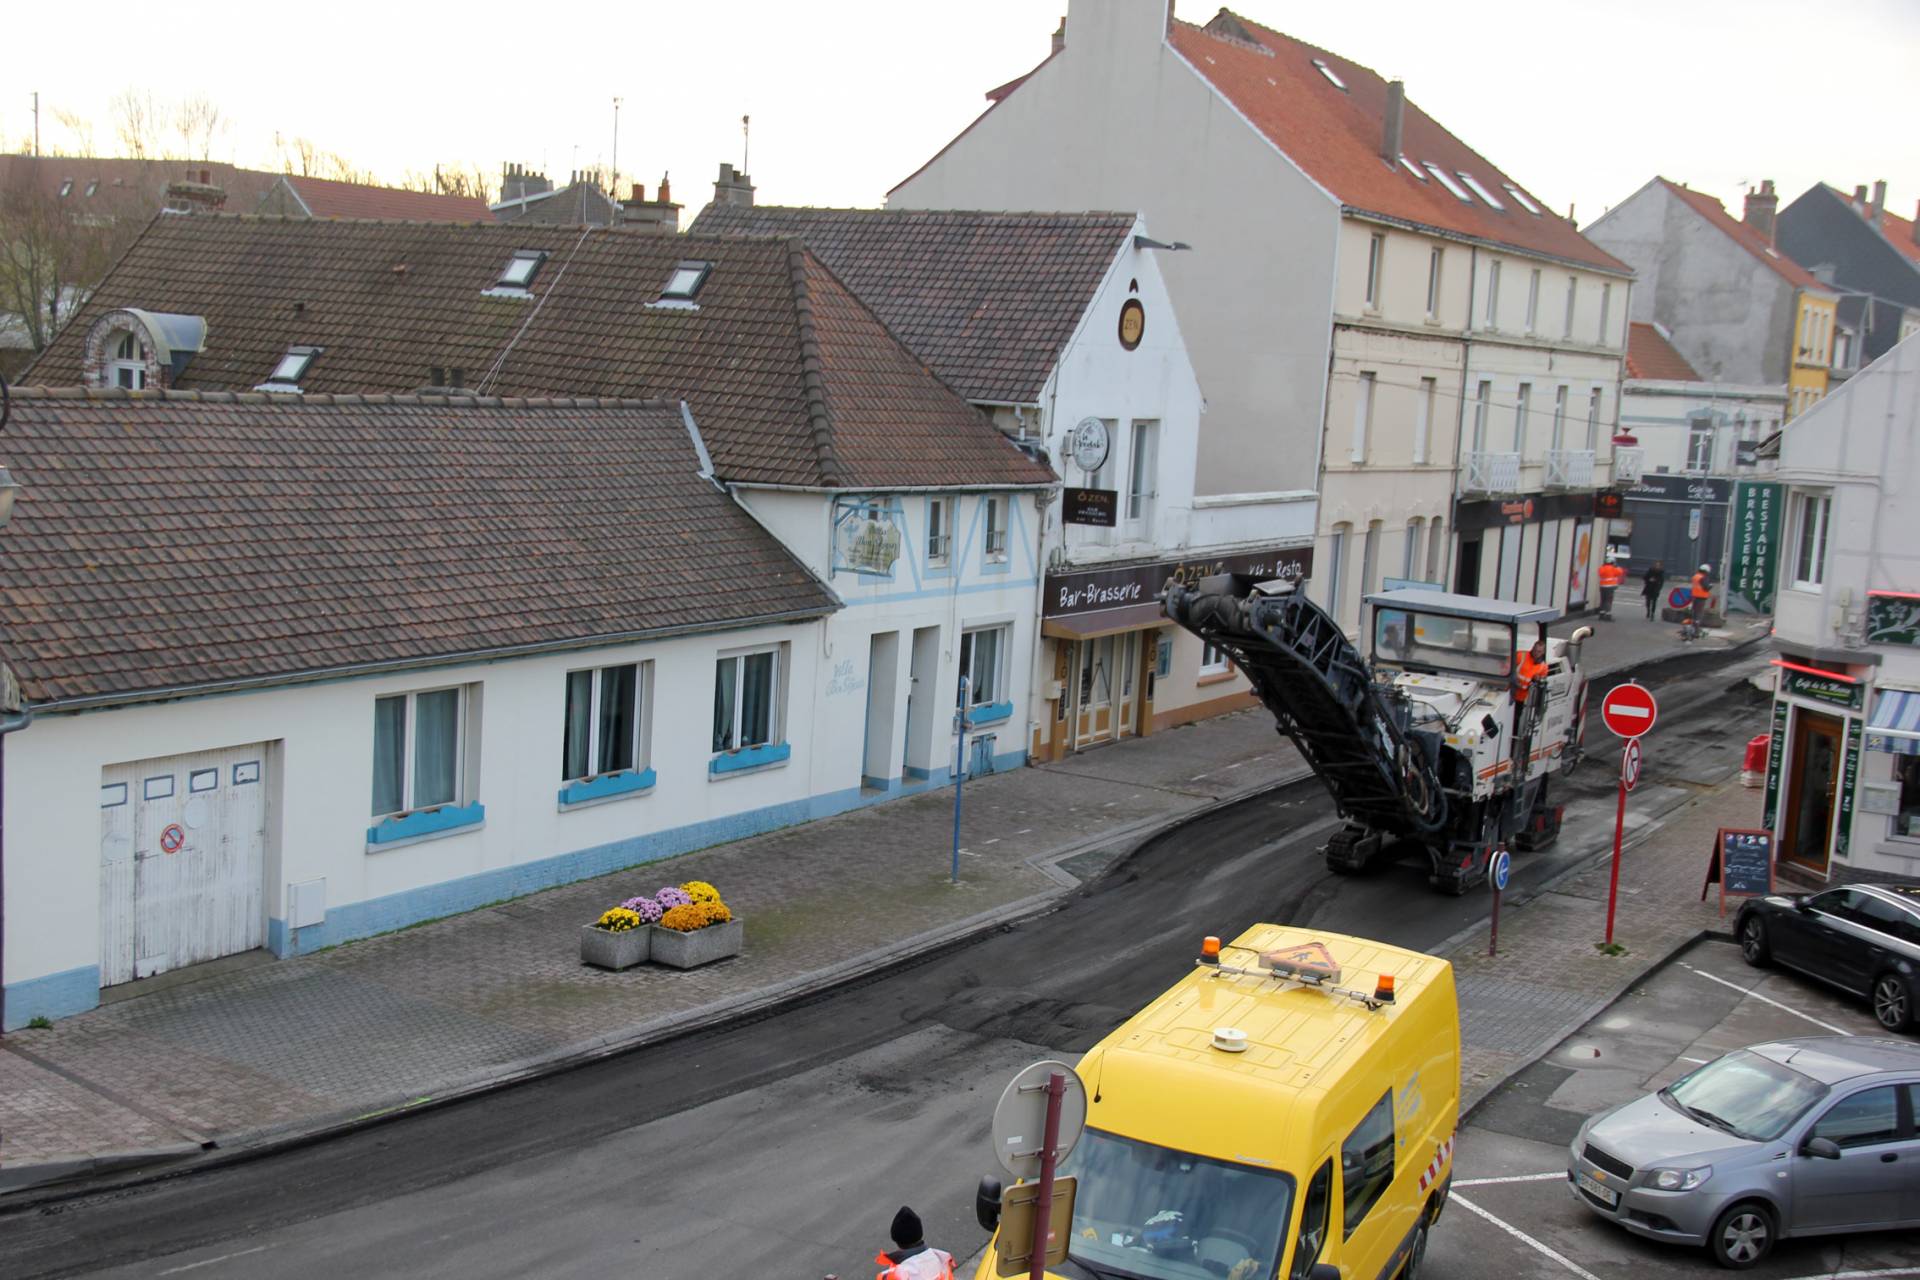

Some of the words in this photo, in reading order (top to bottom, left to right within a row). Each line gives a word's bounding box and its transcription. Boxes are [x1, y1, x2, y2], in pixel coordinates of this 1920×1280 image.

[1059, 581, 1141, 608] Bar-Brasserie
[1276, 559, 1302, 579] Resto
[1739, 487, 1757, 588] BRASSERIE
[1752, 488, 1771, 600] RESTAURANT
